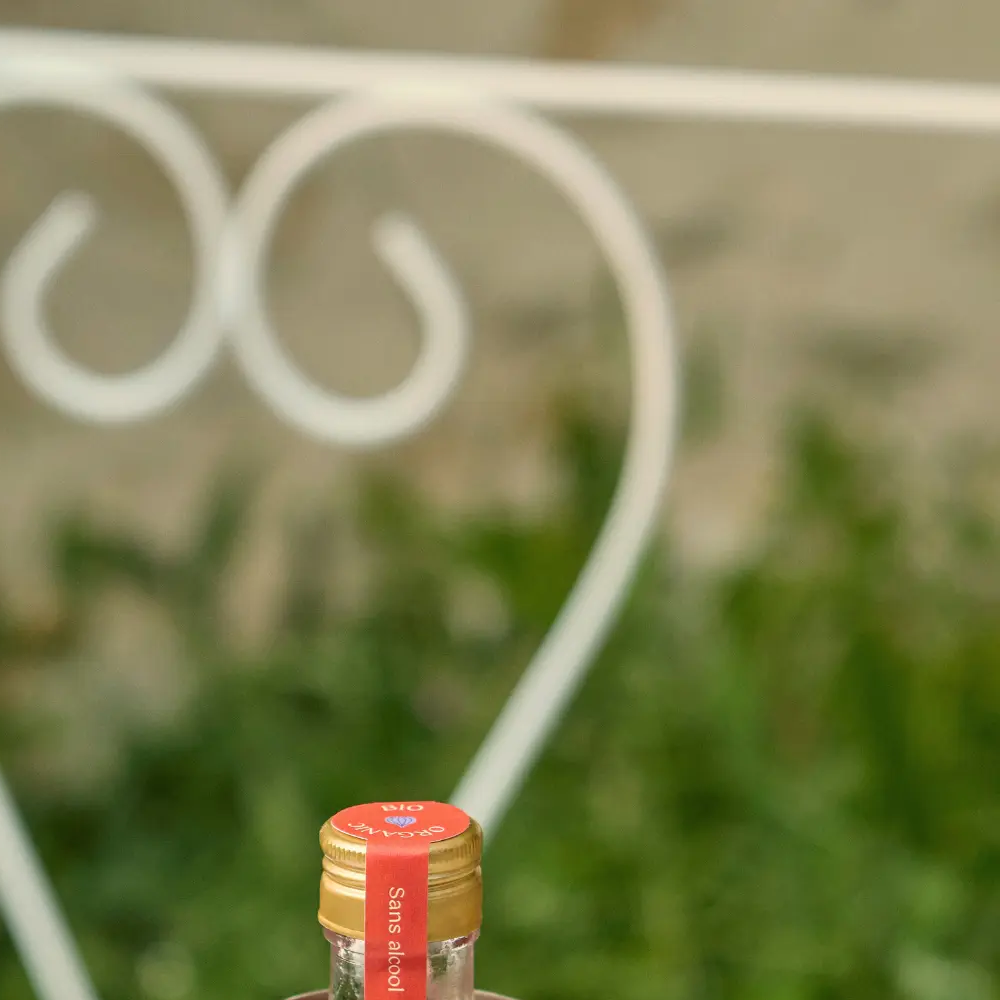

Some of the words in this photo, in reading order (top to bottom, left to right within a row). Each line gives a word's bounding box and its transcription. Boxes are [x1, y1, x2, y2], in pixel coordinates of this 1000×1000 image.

[381, 804, 424, 812] BIO
[348, 822, 445, 839] ORGANIC
[388, 887, 405, 934] Sans
[387, 941, 405, 992] alcool
